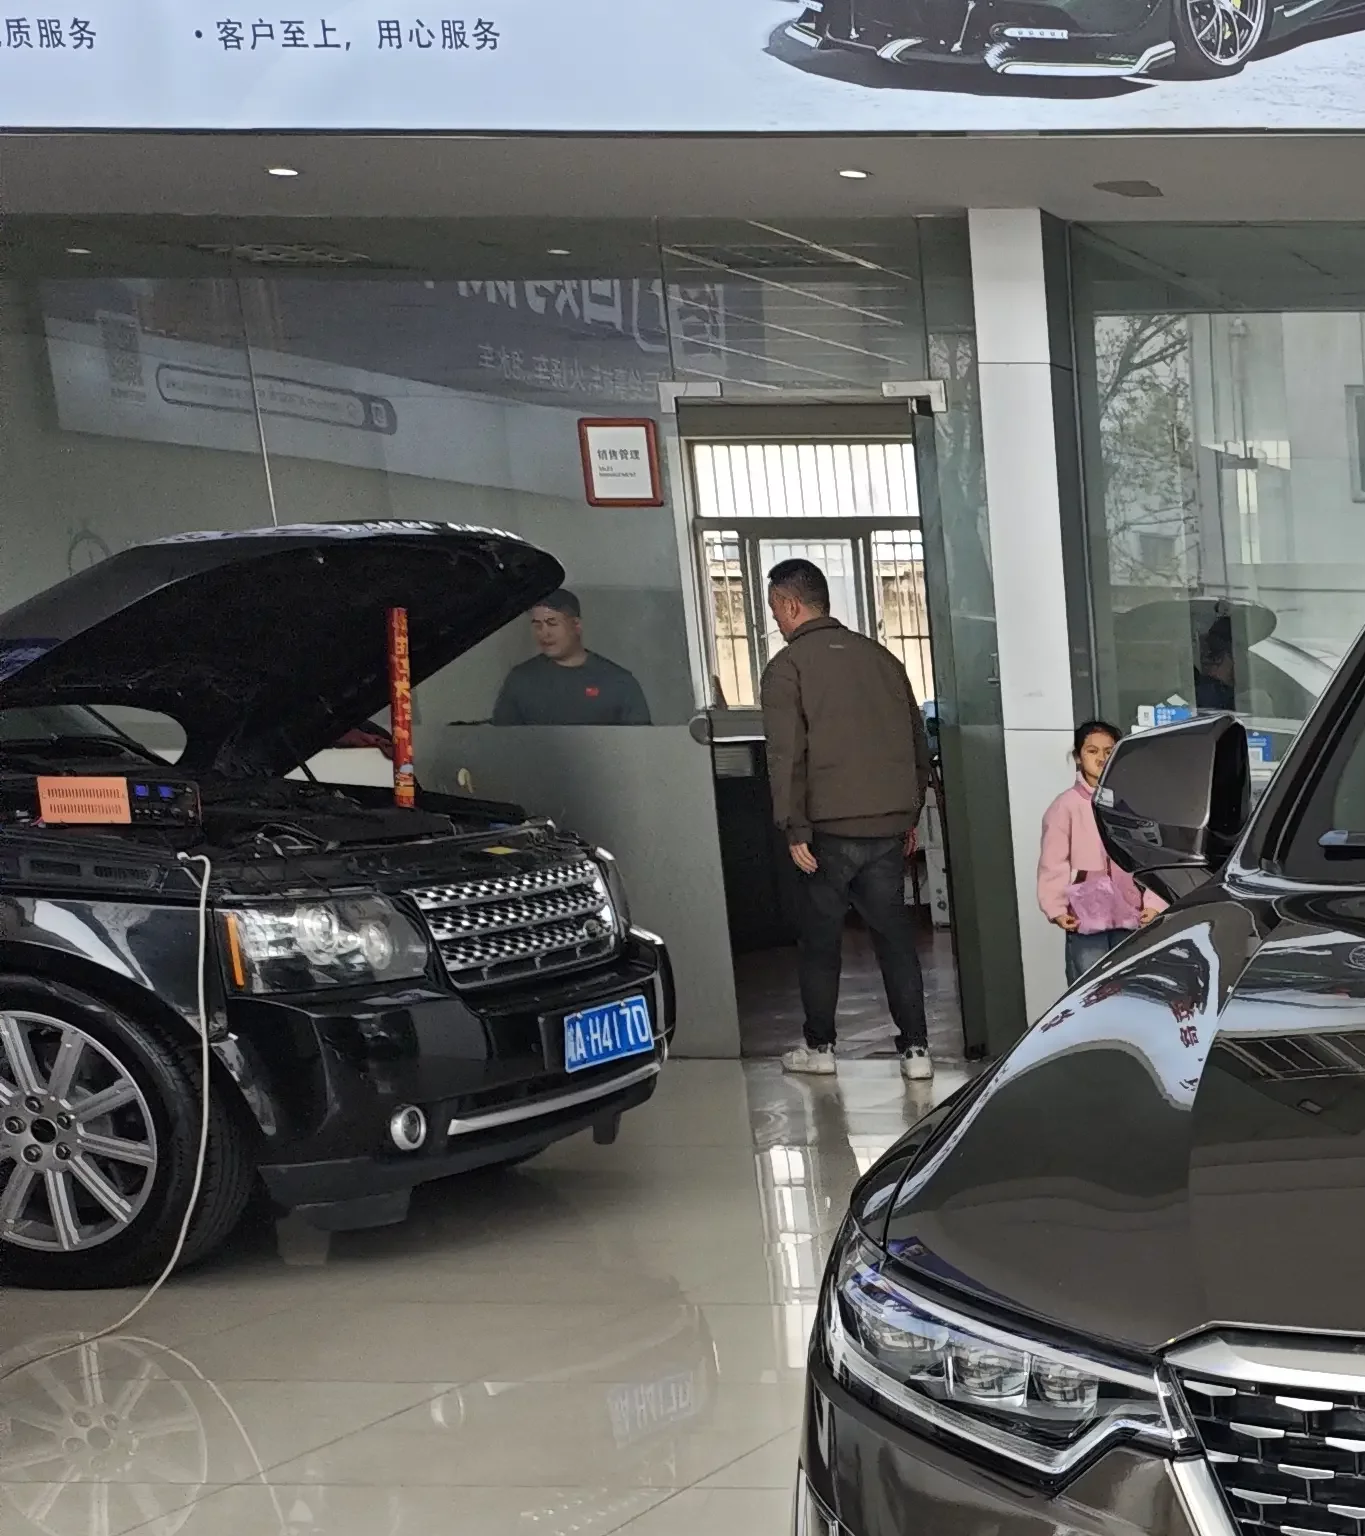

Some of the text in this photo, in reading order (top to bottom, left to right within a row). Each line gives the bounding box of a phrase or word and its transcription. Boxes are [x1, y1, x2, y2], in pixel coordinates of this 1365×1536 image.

[0, 17, 97, 50] 质服务
[597, 448, 641, 461] 销售管理
